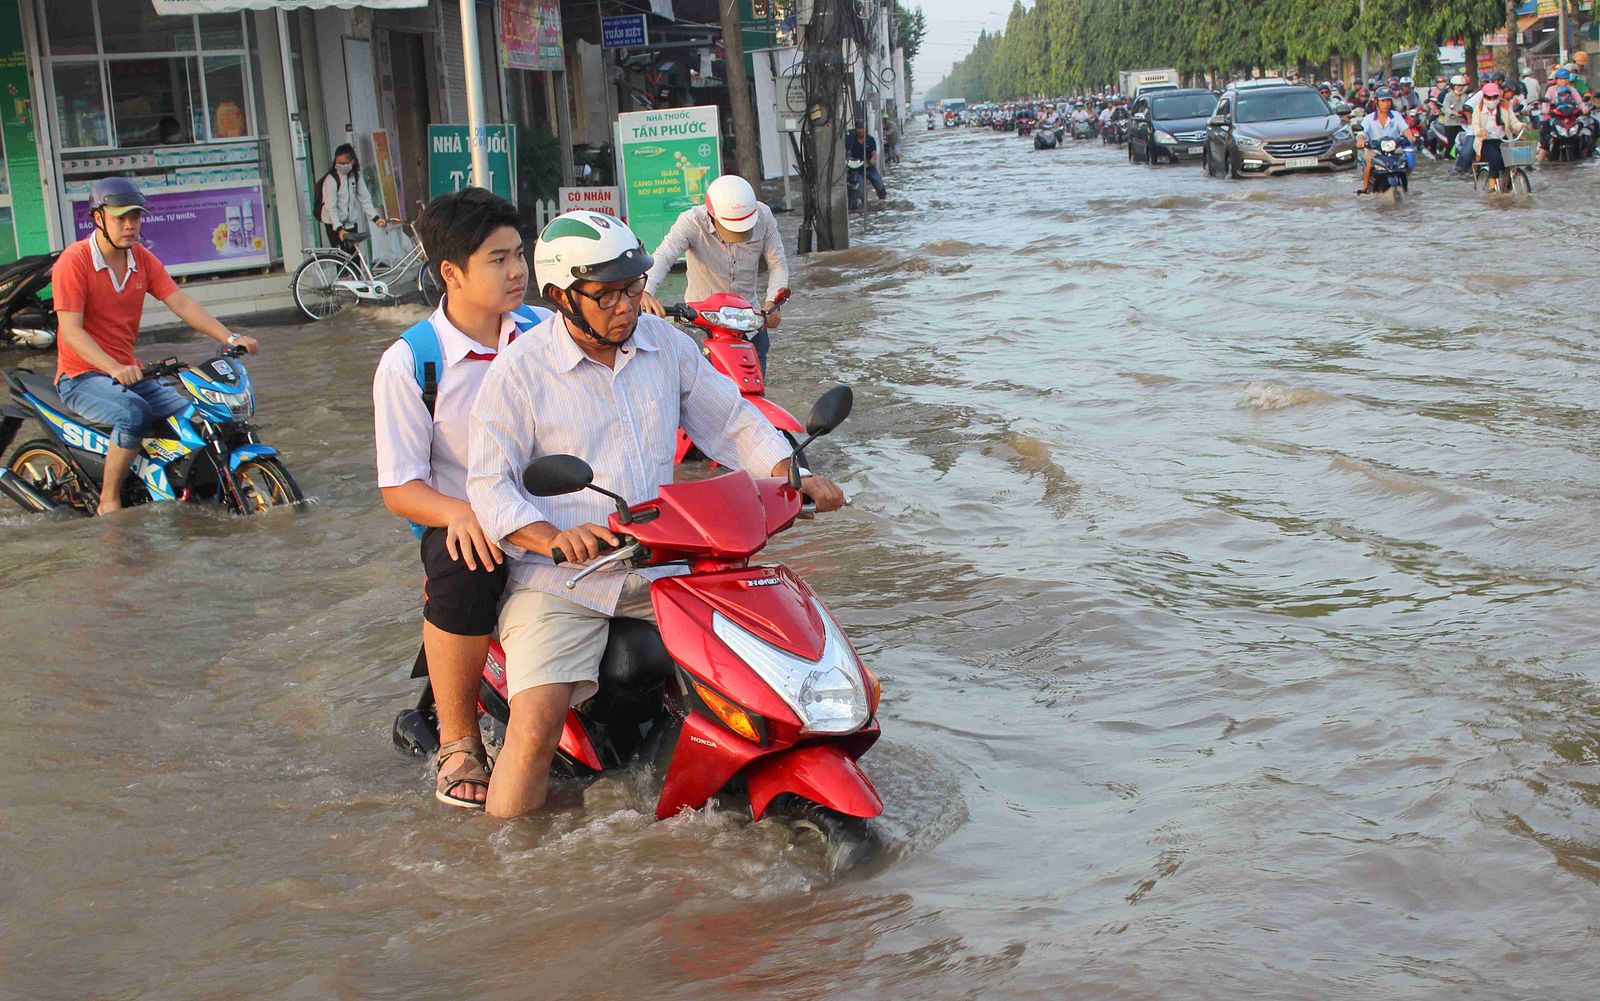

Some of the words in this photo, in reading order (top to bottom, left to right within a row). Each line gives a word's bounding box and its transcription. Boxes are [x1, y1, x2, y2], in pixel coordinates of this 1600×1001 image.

[646, 113, 663, 122] NHÀ
[664, 111, 690, 120] THUỐC
[660, 120, 706, 136] PHƯỚC
[433, 132, 463, 153] NHÀ
[568, 190, 581, 201] CÓ
[583, 189, 611, 203] NHẬN
[746, 577, 780, 587] HONDA
[690, 735, 718, 748] HONDA
